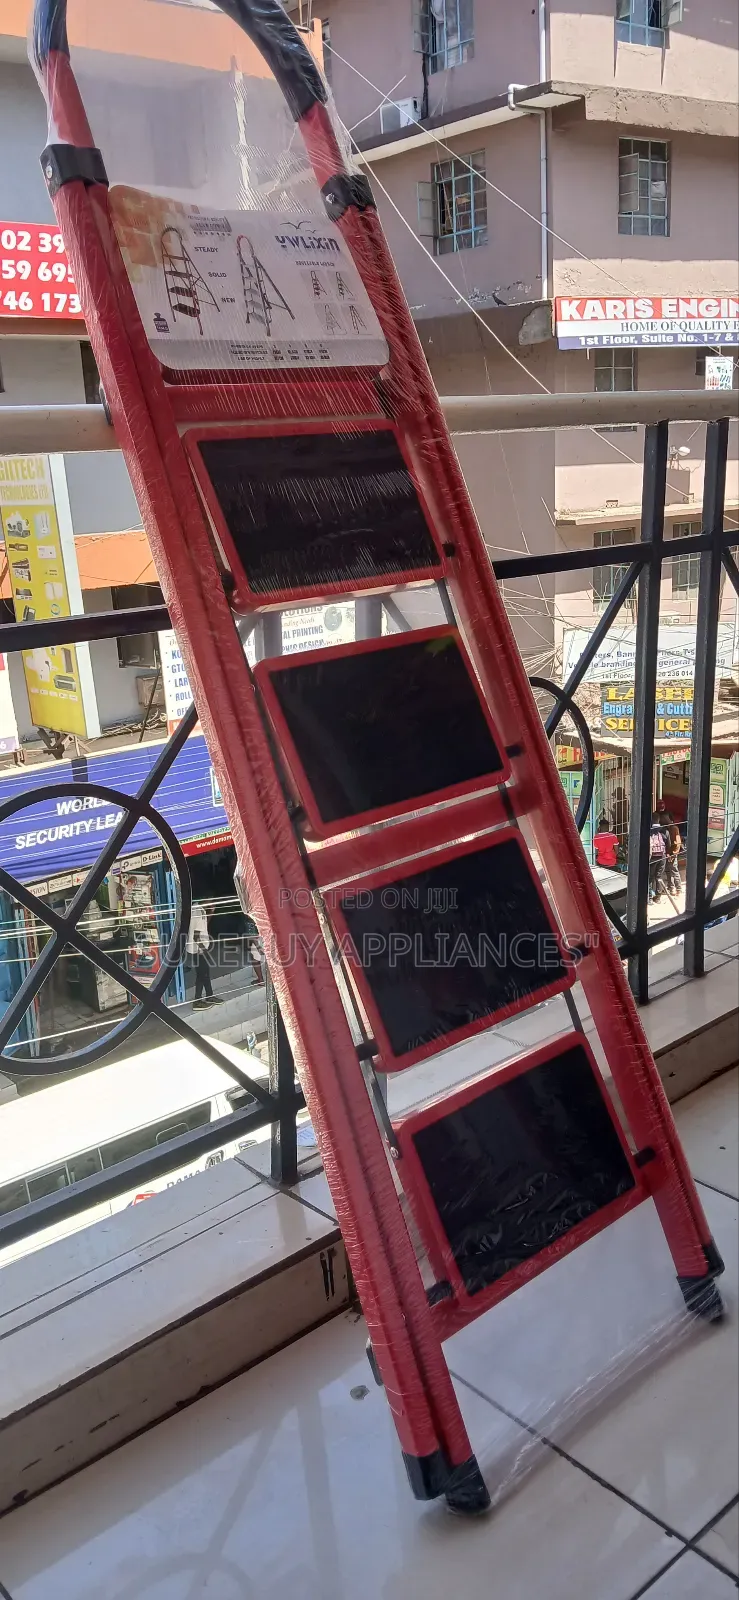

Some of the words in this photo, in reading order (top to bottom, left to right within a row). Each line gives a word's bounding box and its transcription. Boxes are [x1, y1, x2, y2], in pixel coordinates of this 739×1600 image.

[0, 291, 33, 311] 46
[41, 293, 82, 313] 173
[561, 299, 654, 321] KARIS
[621, 322, 658, 332] HOME
[661, 321, 678, 331] OF
[679, 320, 731, 333] QUALITY
[579, 336, 599, 346] 1st
[603, 334, 638, 345] Floor,
[642, 333, 674, 343] Suite
[678, 333, 698, 343] No.
[702, 333, 721, 342] 1-7
[725, 332, 734, 341] &
[292, 625, 324, 639] PRINTING
[603, 702, 633, 717] Engra
[657, 703, 665, 715] &
[667, 703, 693, 715] Cutti
[15, 819, 94, 850] SECURITY
